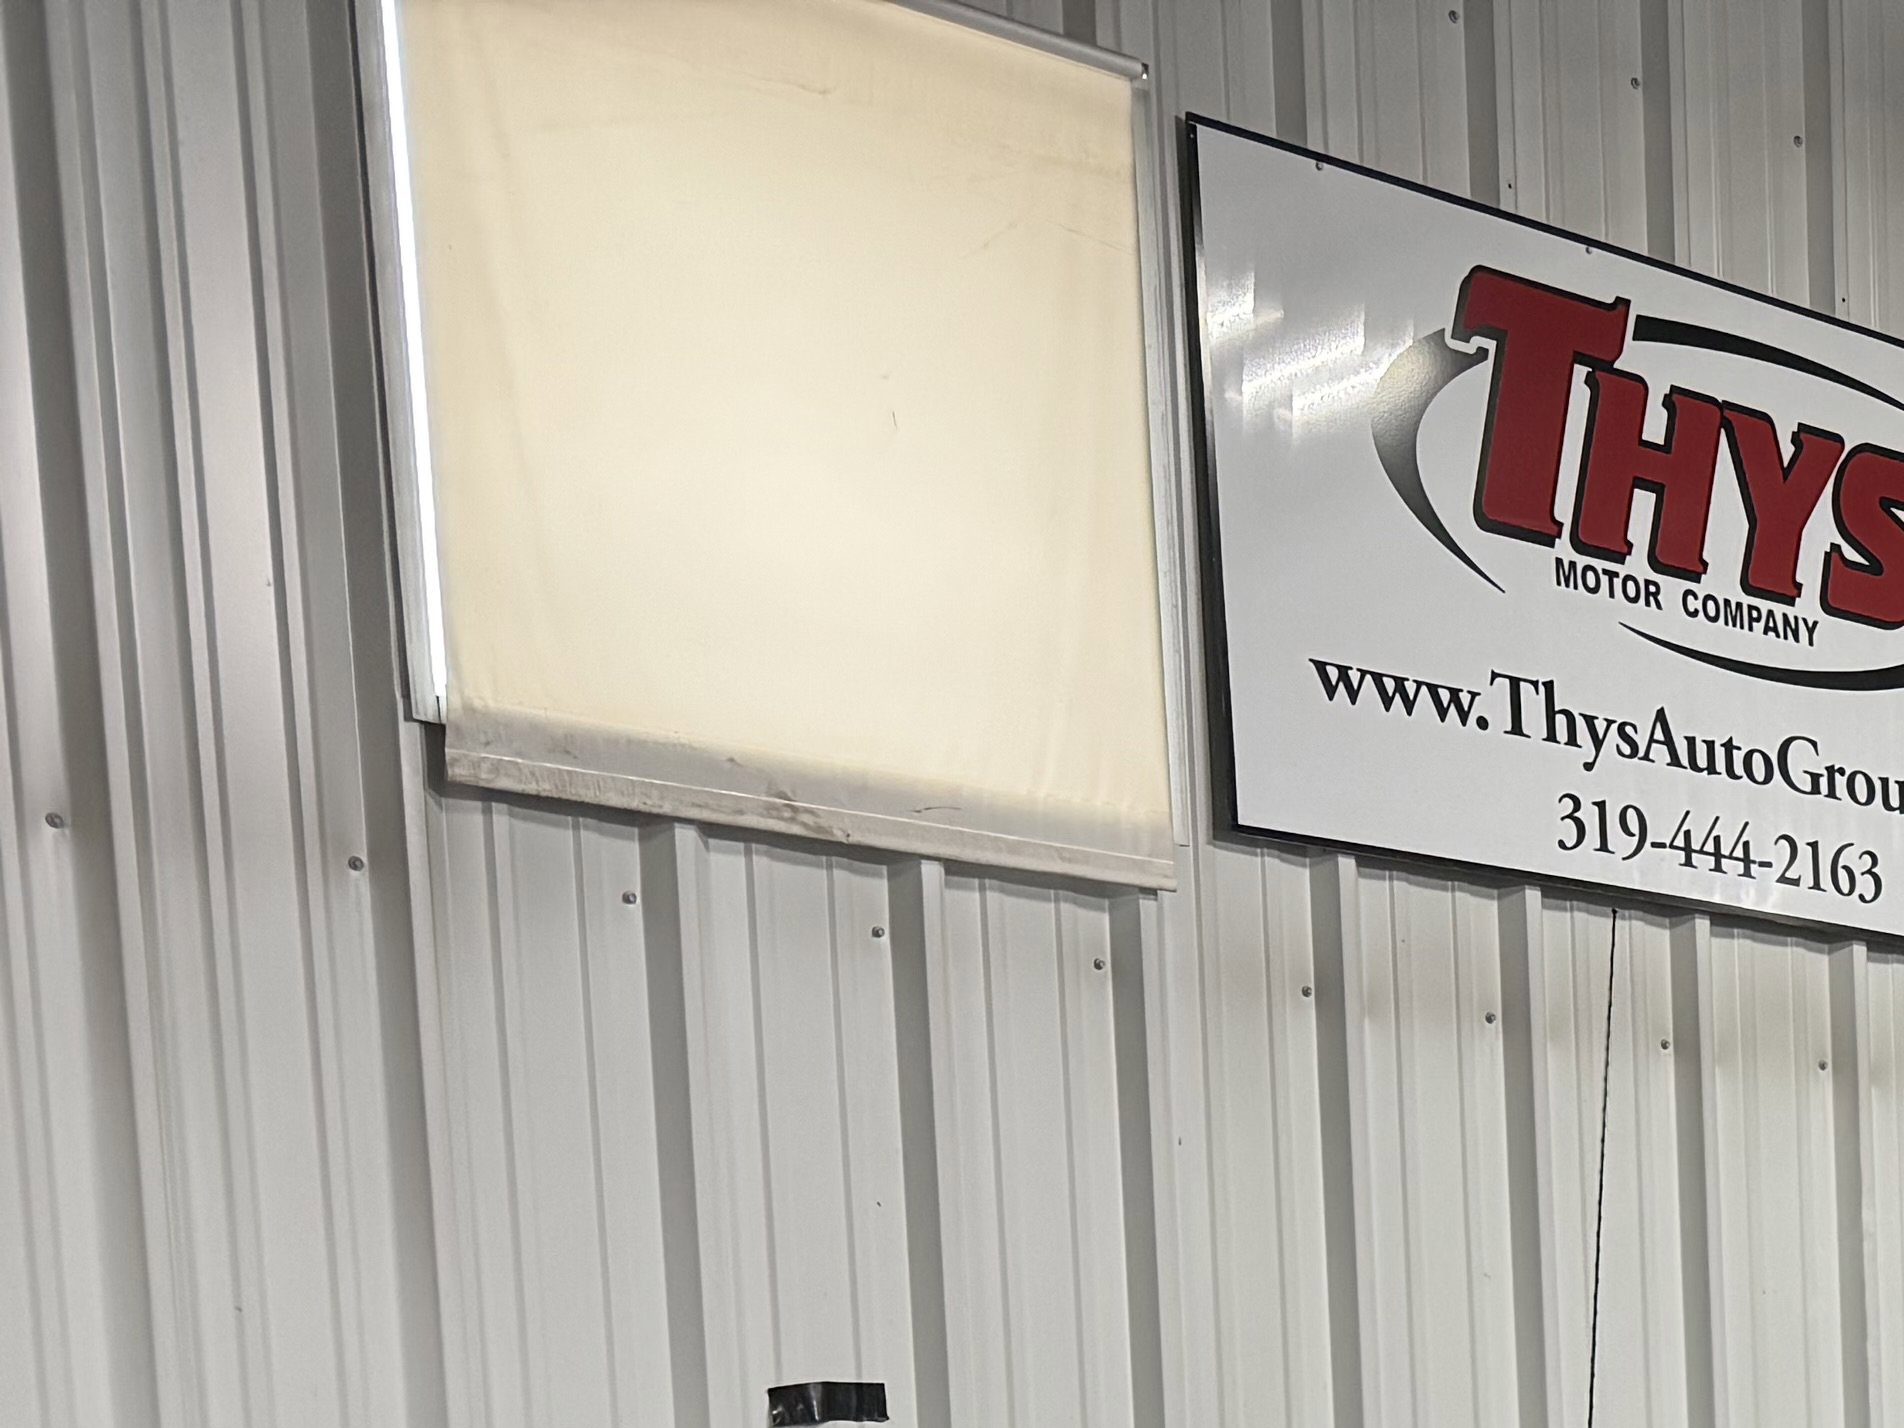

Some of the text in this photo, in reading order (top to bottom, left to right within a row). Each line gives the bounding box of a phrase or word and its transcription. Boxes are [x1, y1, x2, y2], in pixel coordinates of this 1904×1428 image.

[1554, 557, 1820, 648] MOTOR COMPANY
[1556, 791, 1885, 905] 319-444-2163
